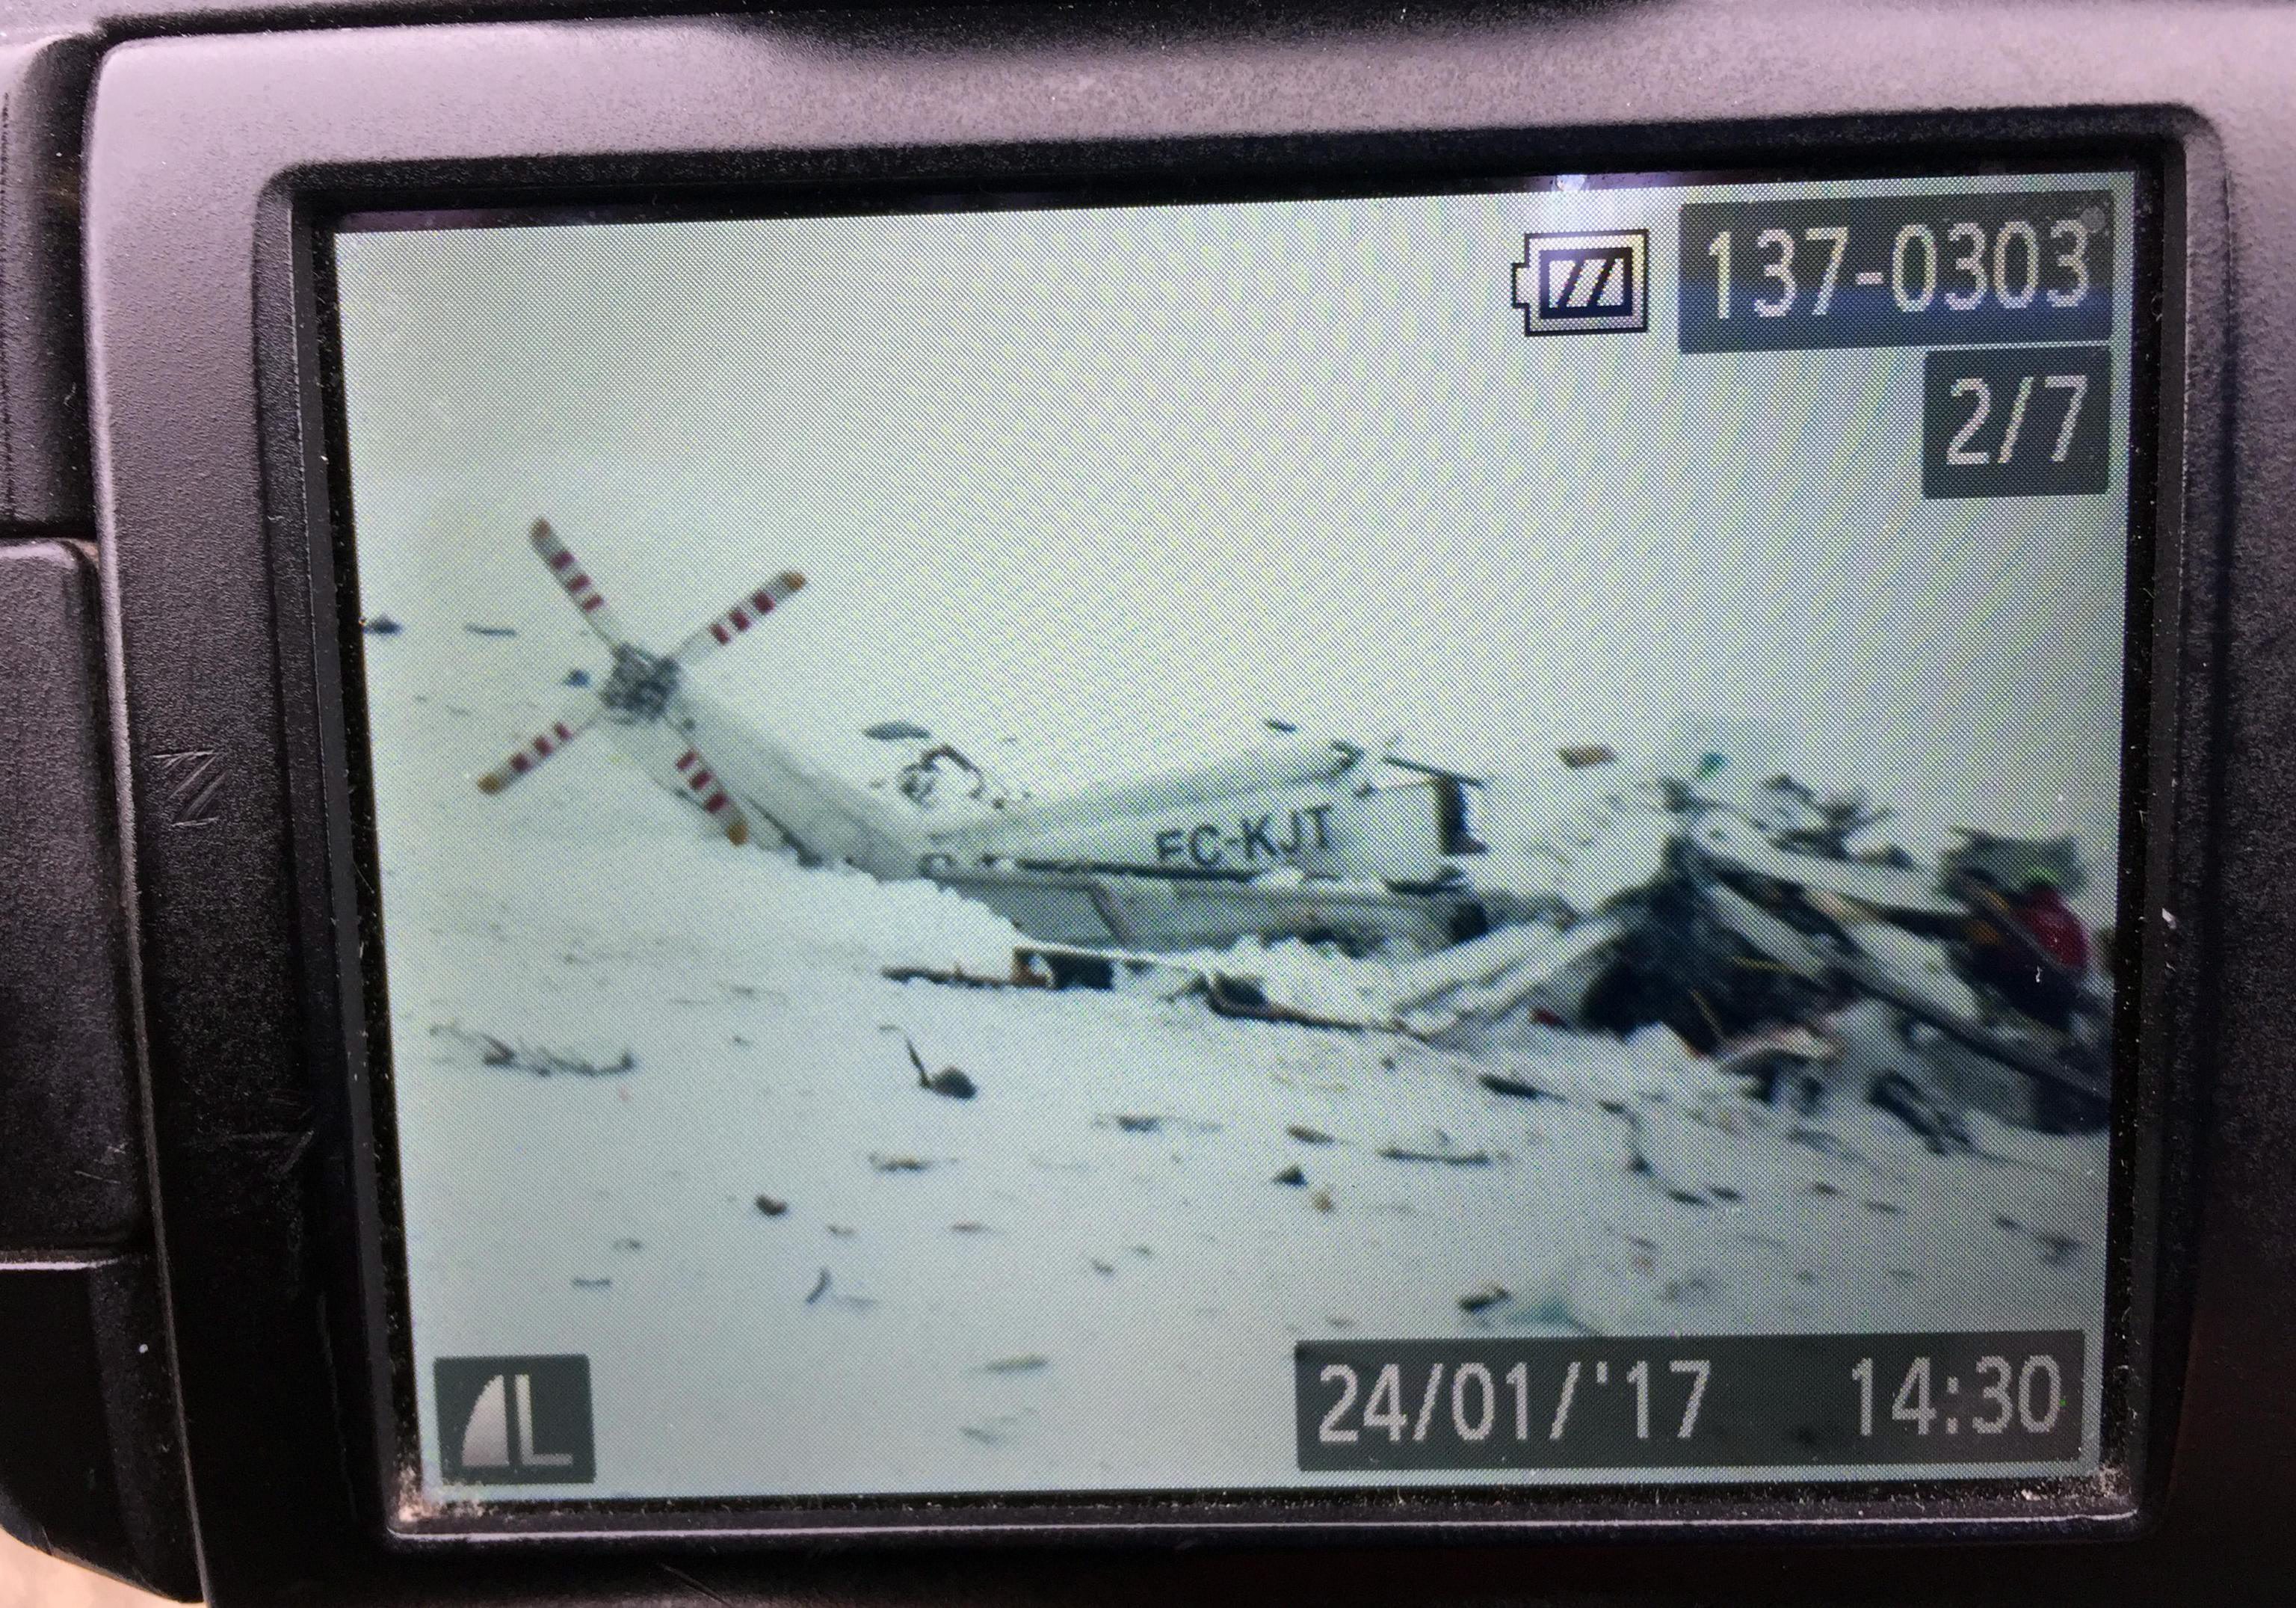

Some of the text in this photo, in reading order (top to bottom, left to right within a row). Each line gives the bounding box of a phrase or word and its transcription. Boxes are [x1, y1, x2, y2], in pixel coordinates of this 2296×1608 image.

[1708, 221, 2091, 319] 137-0303
[1947, 375, 2088, 466] 2/7
[1319, 1355, 2063, 1443] 24/01/'17 14:30
